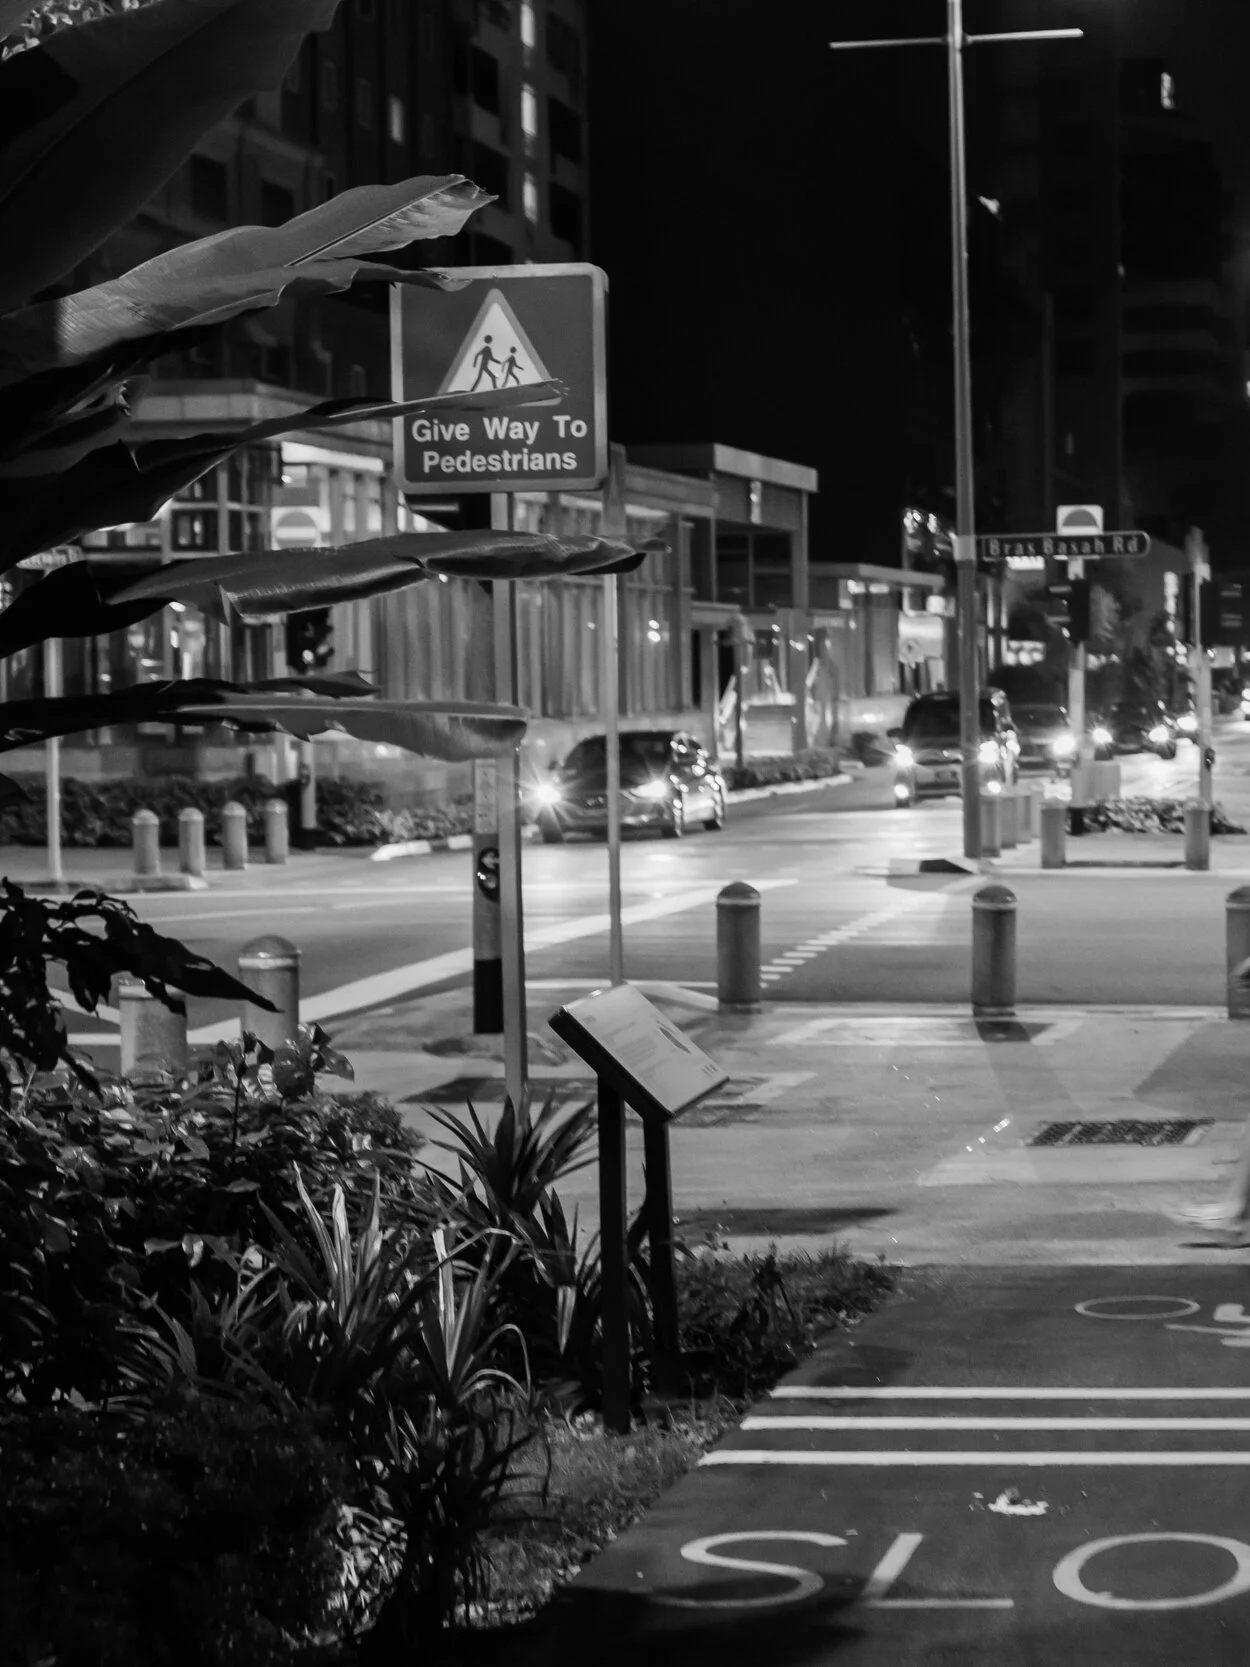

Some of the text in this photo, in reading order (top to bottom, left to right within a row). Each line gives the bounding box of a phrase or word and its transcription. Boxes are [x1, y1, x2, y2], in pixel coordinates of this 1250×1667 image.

[411, 414, 587, 445] Give Way To
[423, 448, 577, 473] Pedestrians
[989, 535, 1138, 556] Bras Basah Rd
